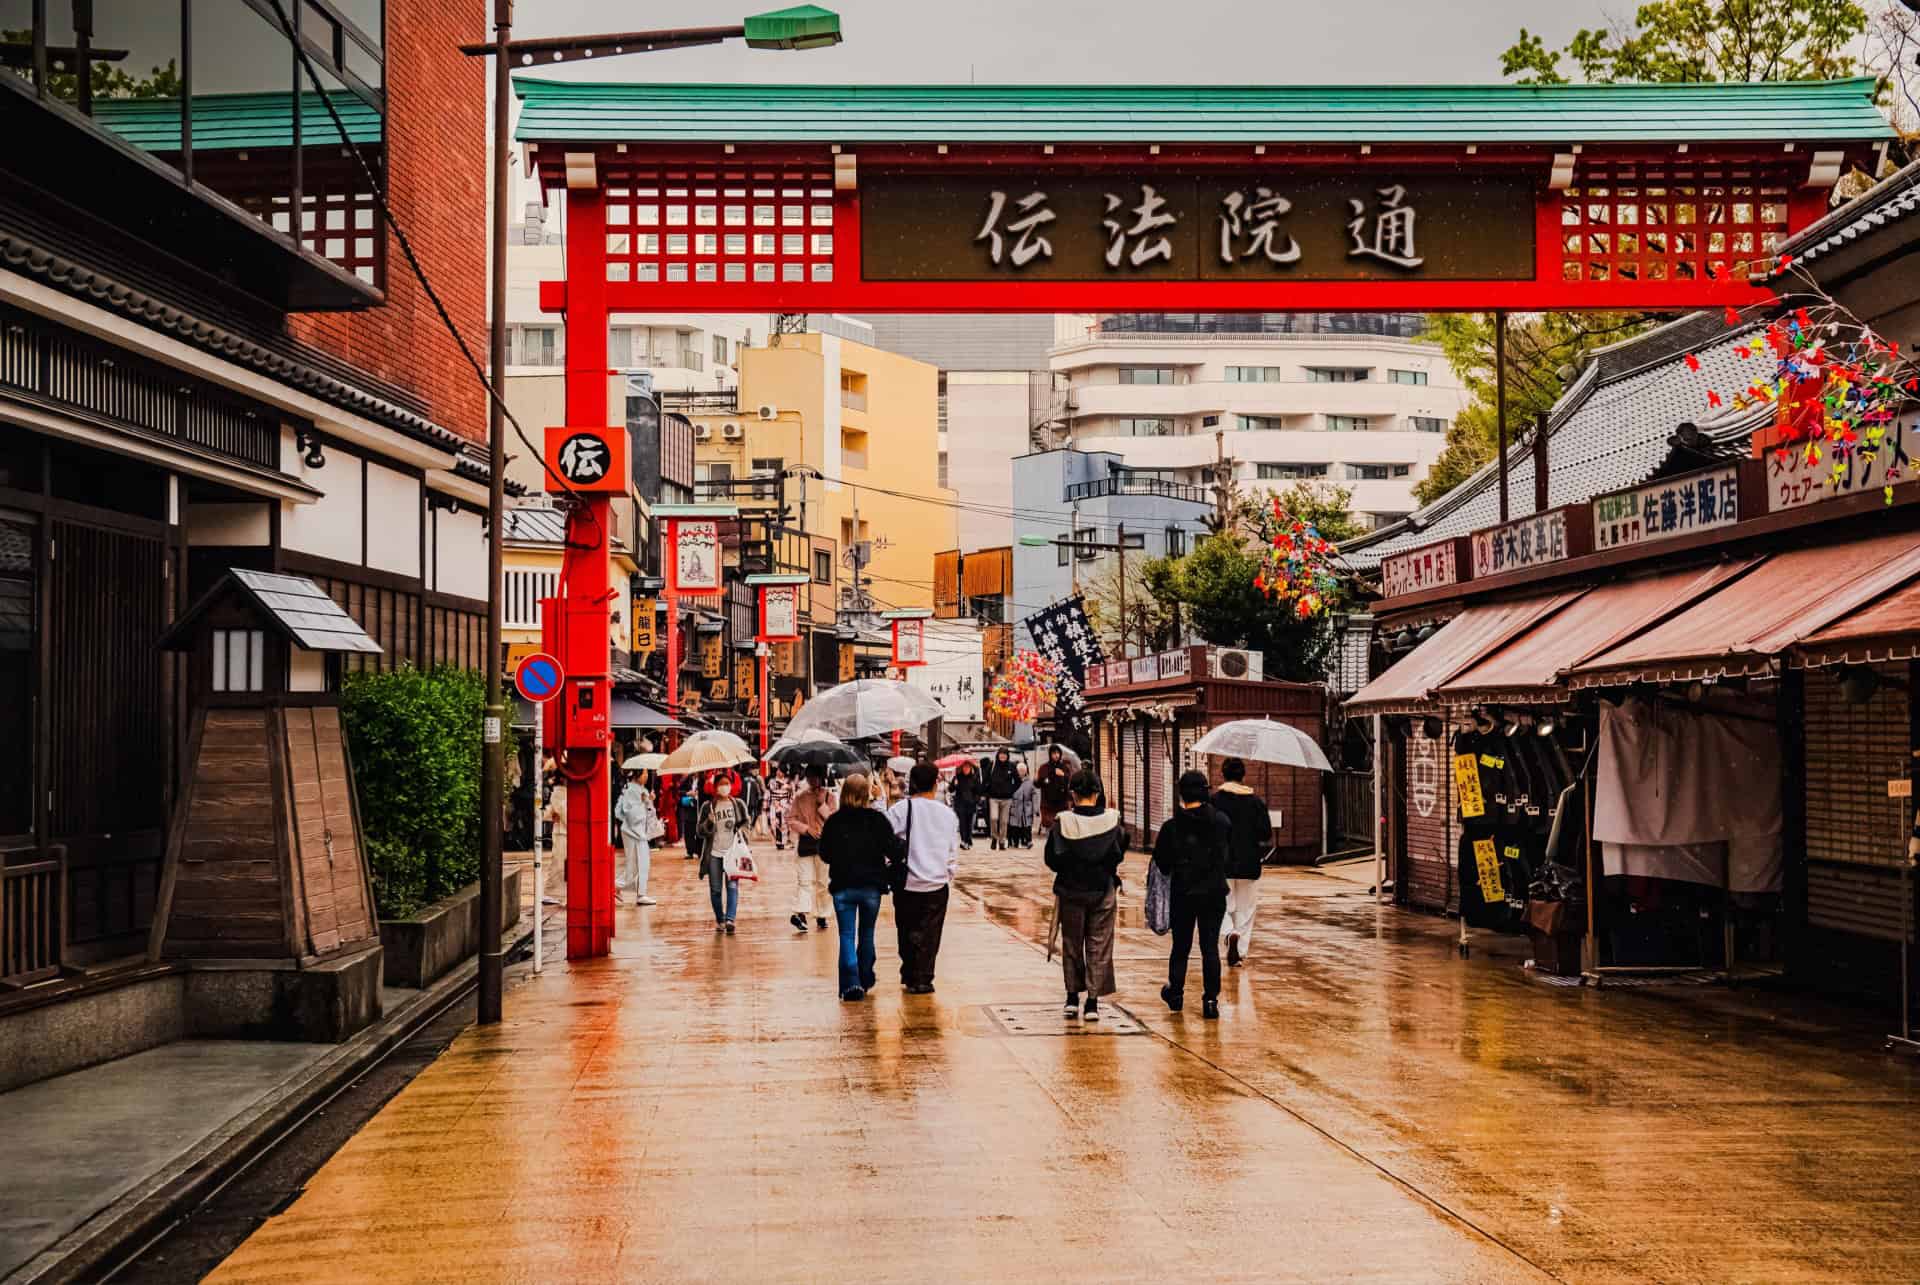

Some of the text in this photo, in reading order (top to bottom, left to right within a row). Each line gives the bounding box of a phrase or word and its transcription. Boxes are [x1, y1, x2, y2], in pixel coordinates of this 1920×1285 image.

[978, 184, 1425, 269] 伝法院通
[560, 439, 604, 478] 伝
[1643, 473, 1737, 536] 佐藤洋服店
